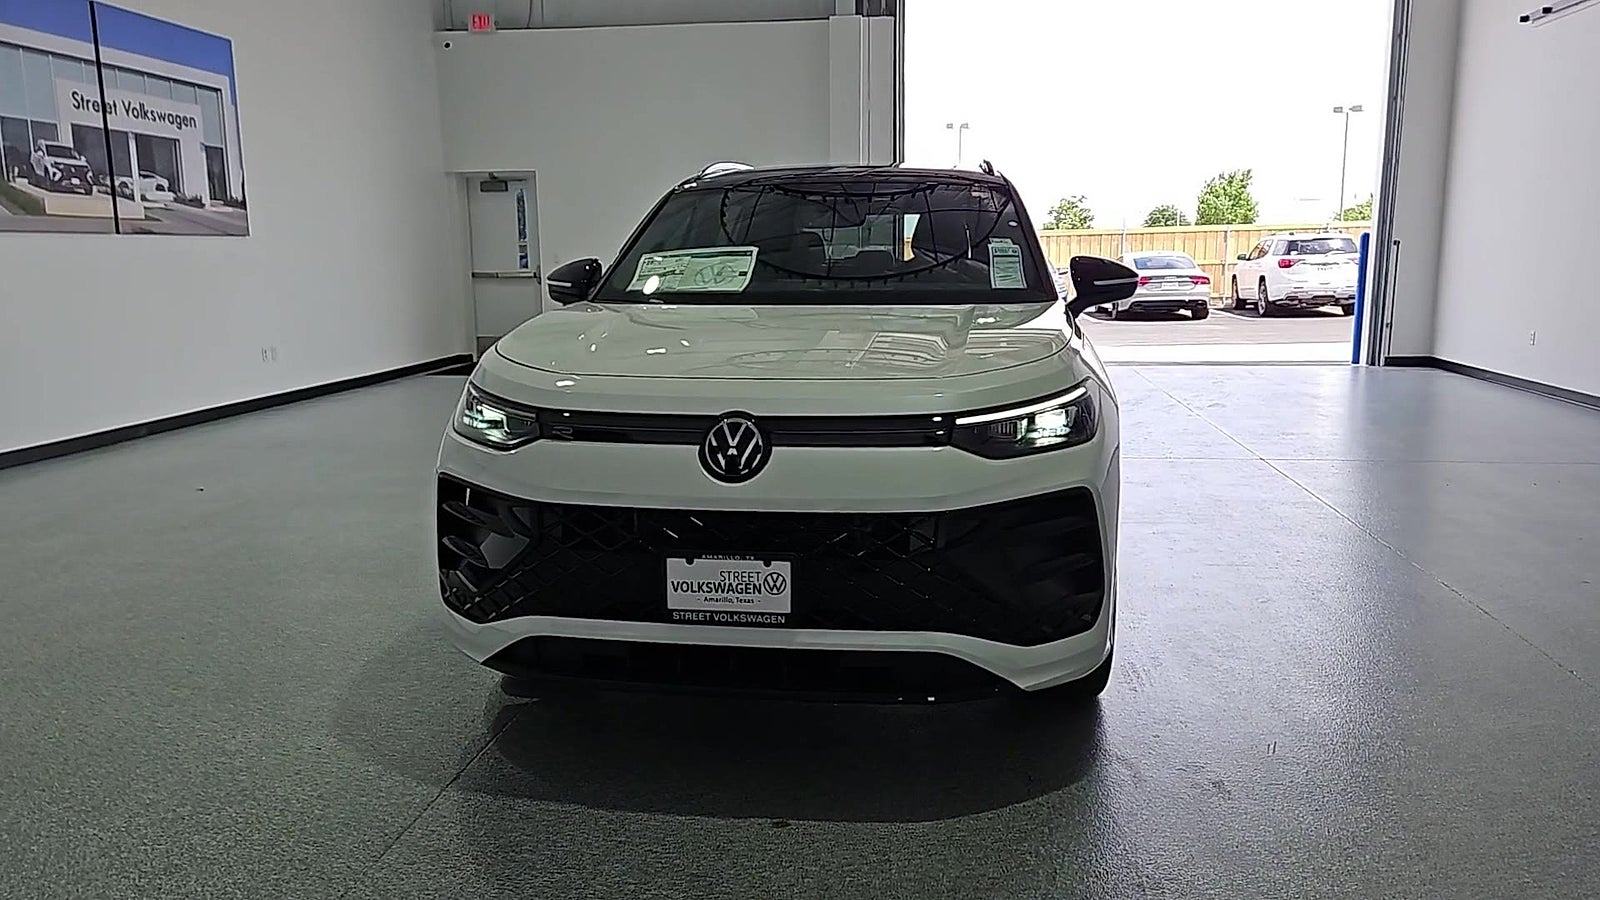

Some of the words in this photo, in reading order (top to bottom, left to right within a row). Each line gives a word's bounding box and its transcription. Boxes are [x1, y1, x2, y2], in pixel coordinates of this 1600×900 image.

[71, 90, 118, 116] Street
[121, 99, 198, 130] Volkswagen
[719, 570, 762, 583] STREET
[671, 580, 763, 595] VOLKSWAGEN
[703, 596, 735, 604] Amarillo,
[735, 596, 755, 604] Texas
[672, 611, 711, 621] STREET
[713, 612, 786, 624] VOLKSWAGEN
